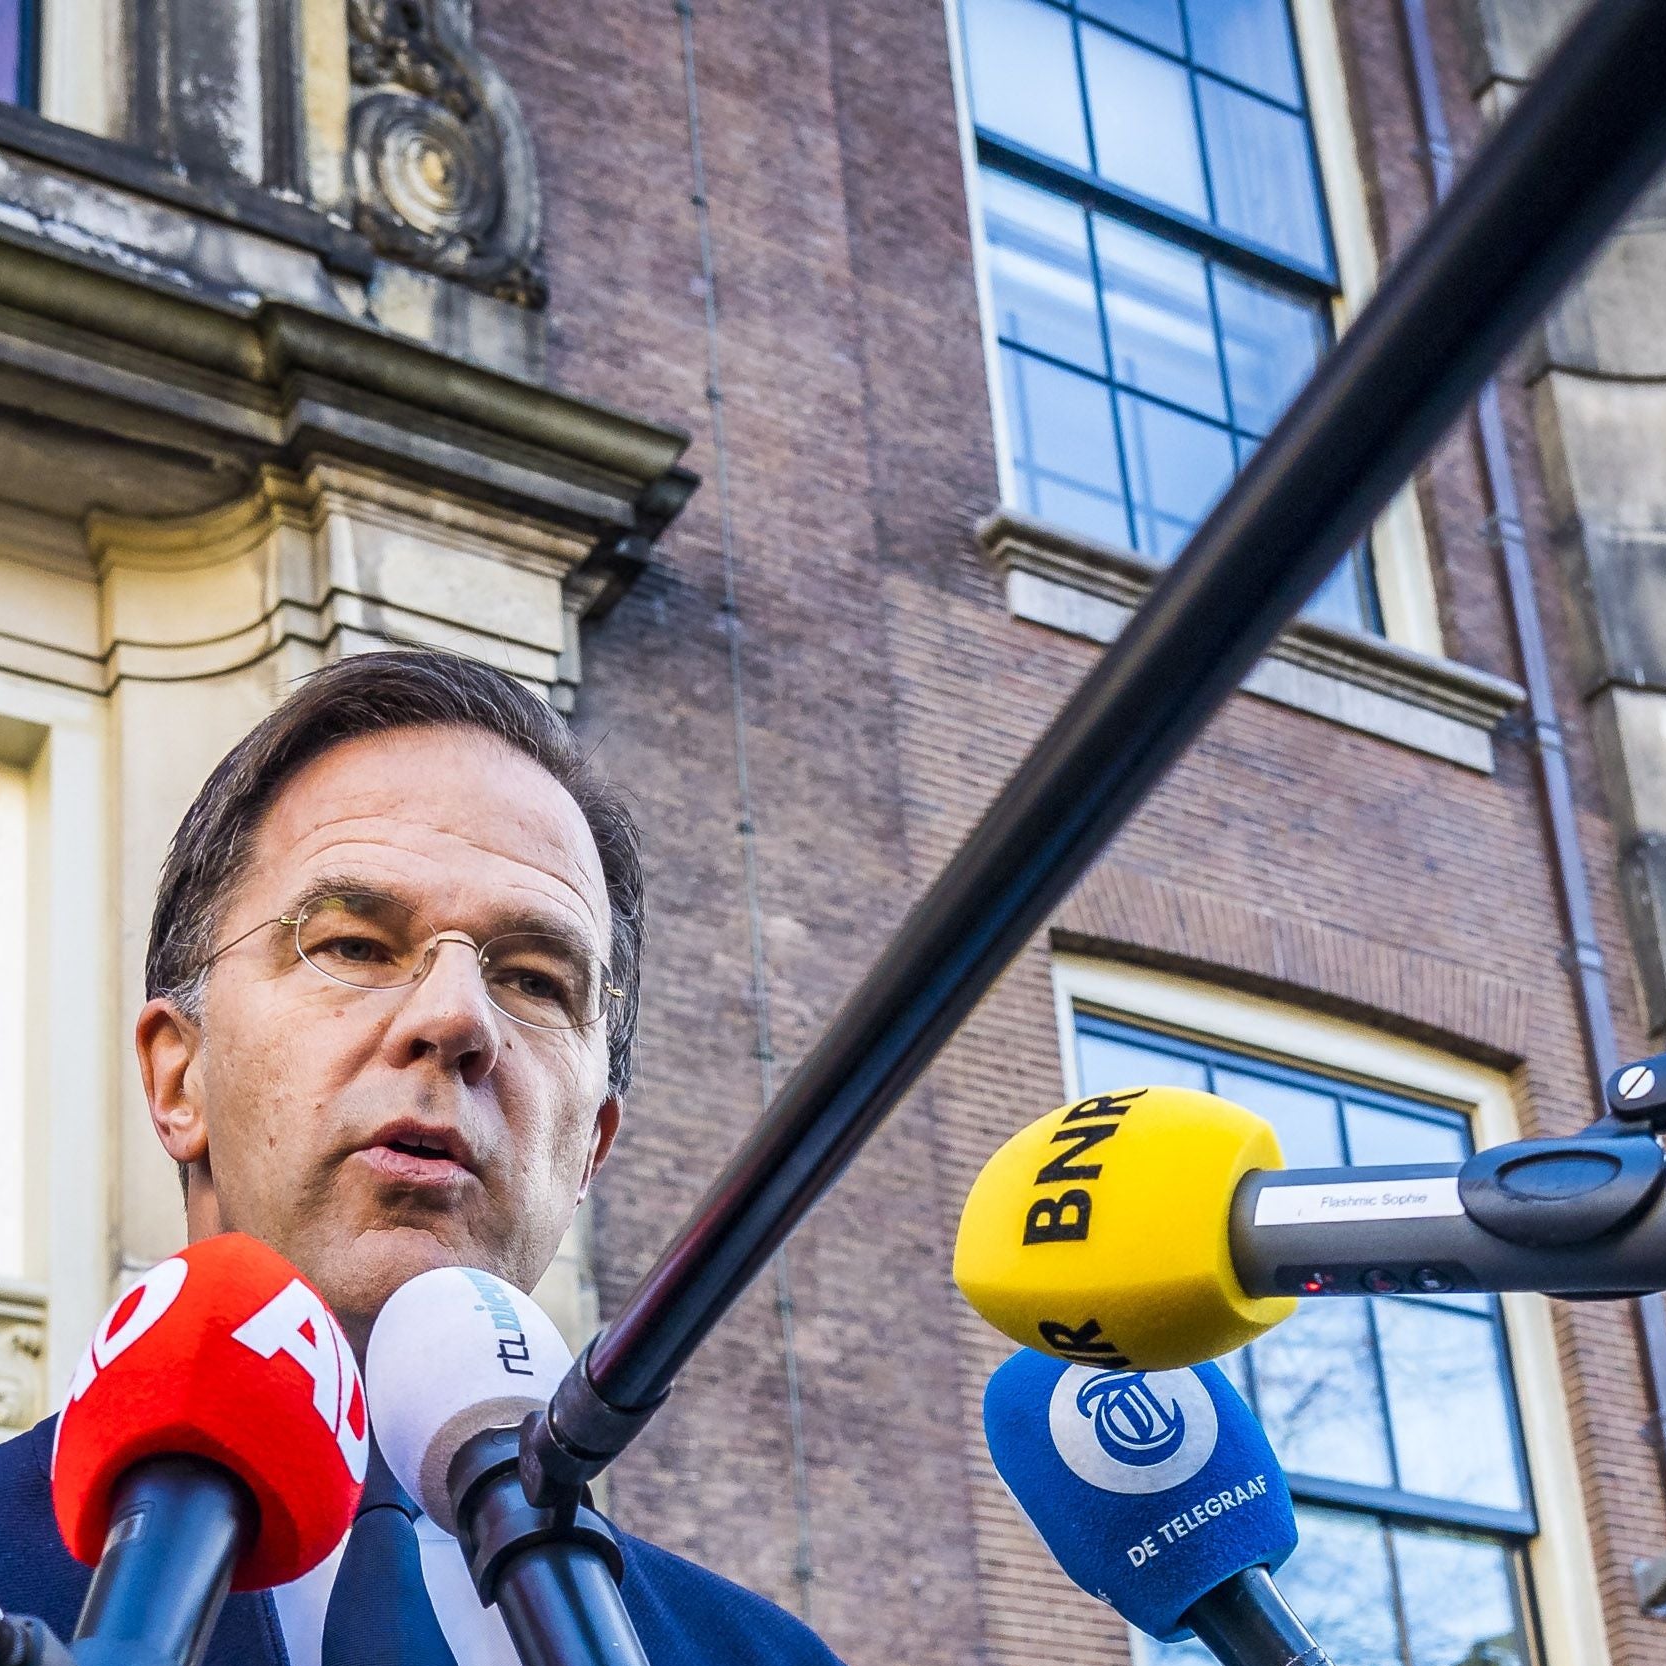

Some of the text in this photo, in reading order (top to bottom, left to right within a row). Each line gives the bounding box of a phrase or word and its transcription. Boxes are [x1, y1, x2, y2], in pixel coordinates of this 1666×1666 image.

[1022, 1088, 1149, 1246] BNR
[1320, 1192, 1428, 1209] Flashmic Sophie
[230, 1278, 370, 1484] AD
[1126, 1474, 1268, 1568] DE TELEGRAAF
